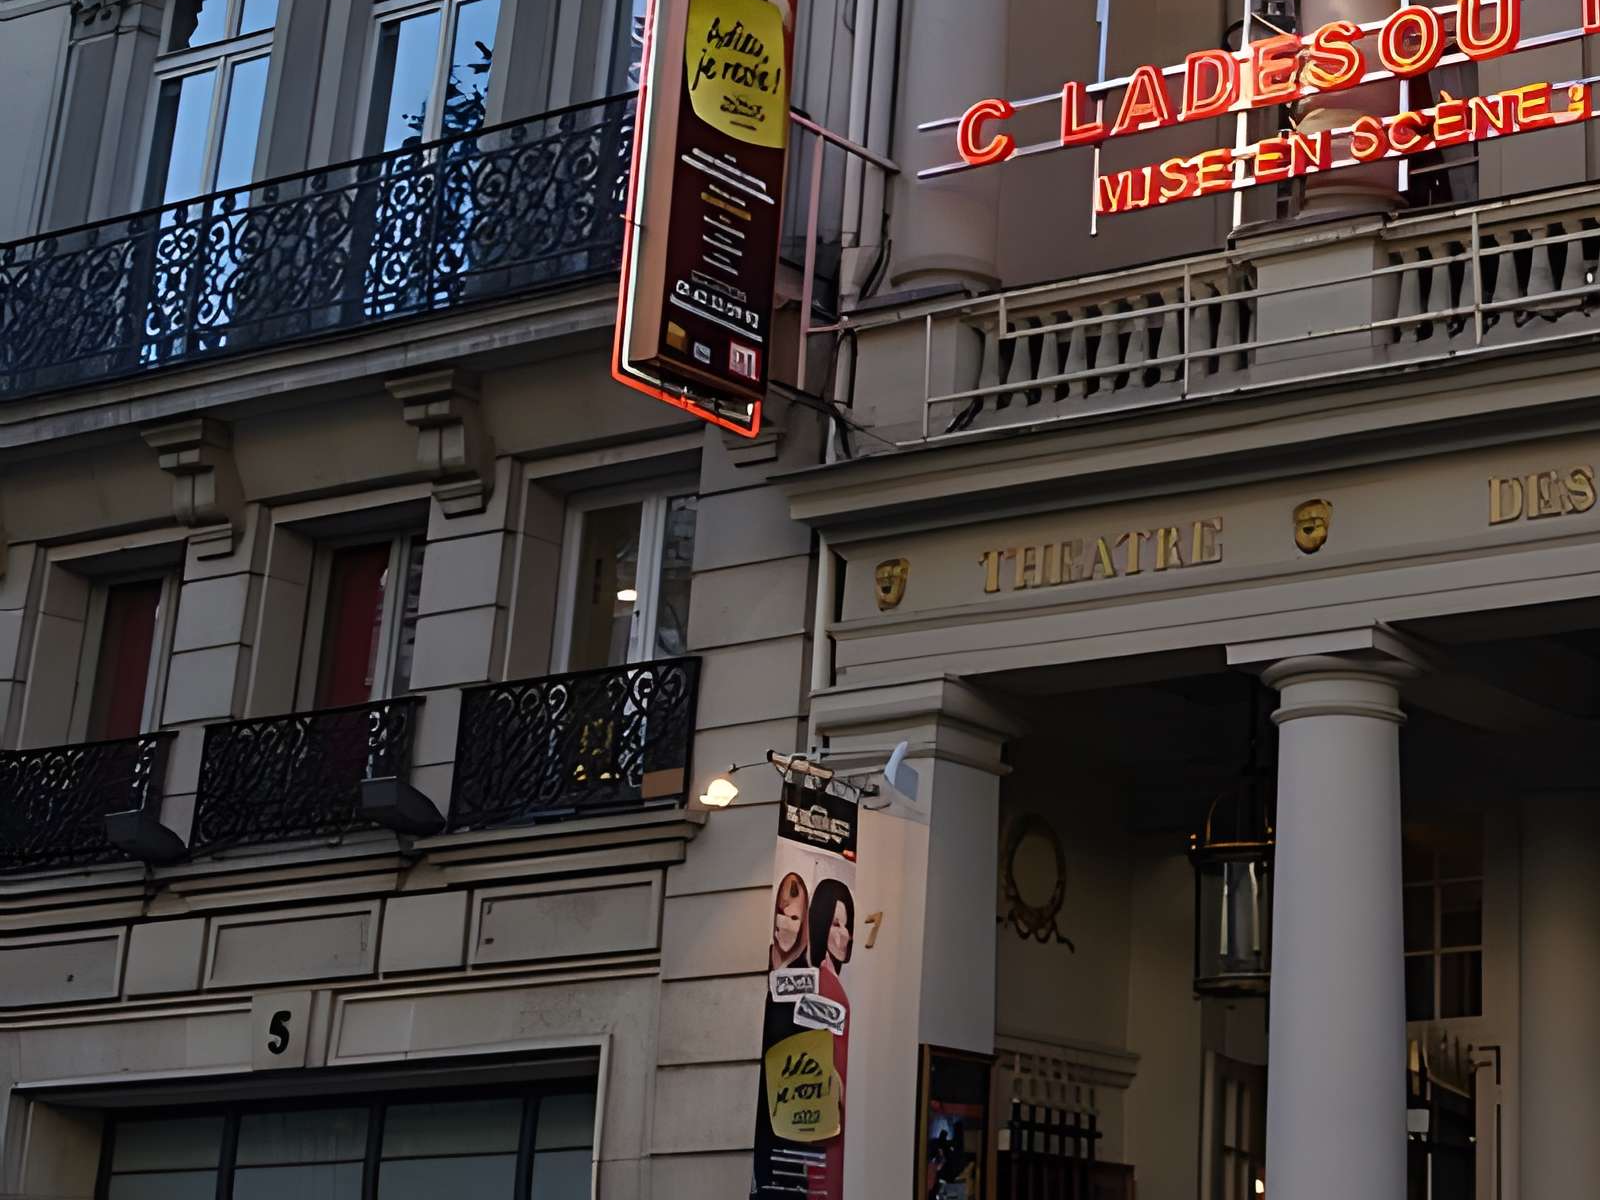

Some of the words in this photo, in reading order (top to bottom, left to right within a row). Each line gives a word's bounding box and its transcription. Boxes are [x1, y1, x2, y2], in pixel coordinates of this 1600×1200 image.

[1255, 130, 1332, 185] EN
[977, 516, 1224, 593] THEATRE
[1487, 464, 1598, 527] DES
[864, 911, 883, 949] 7
[267, 1010, 292, 1055] 5
